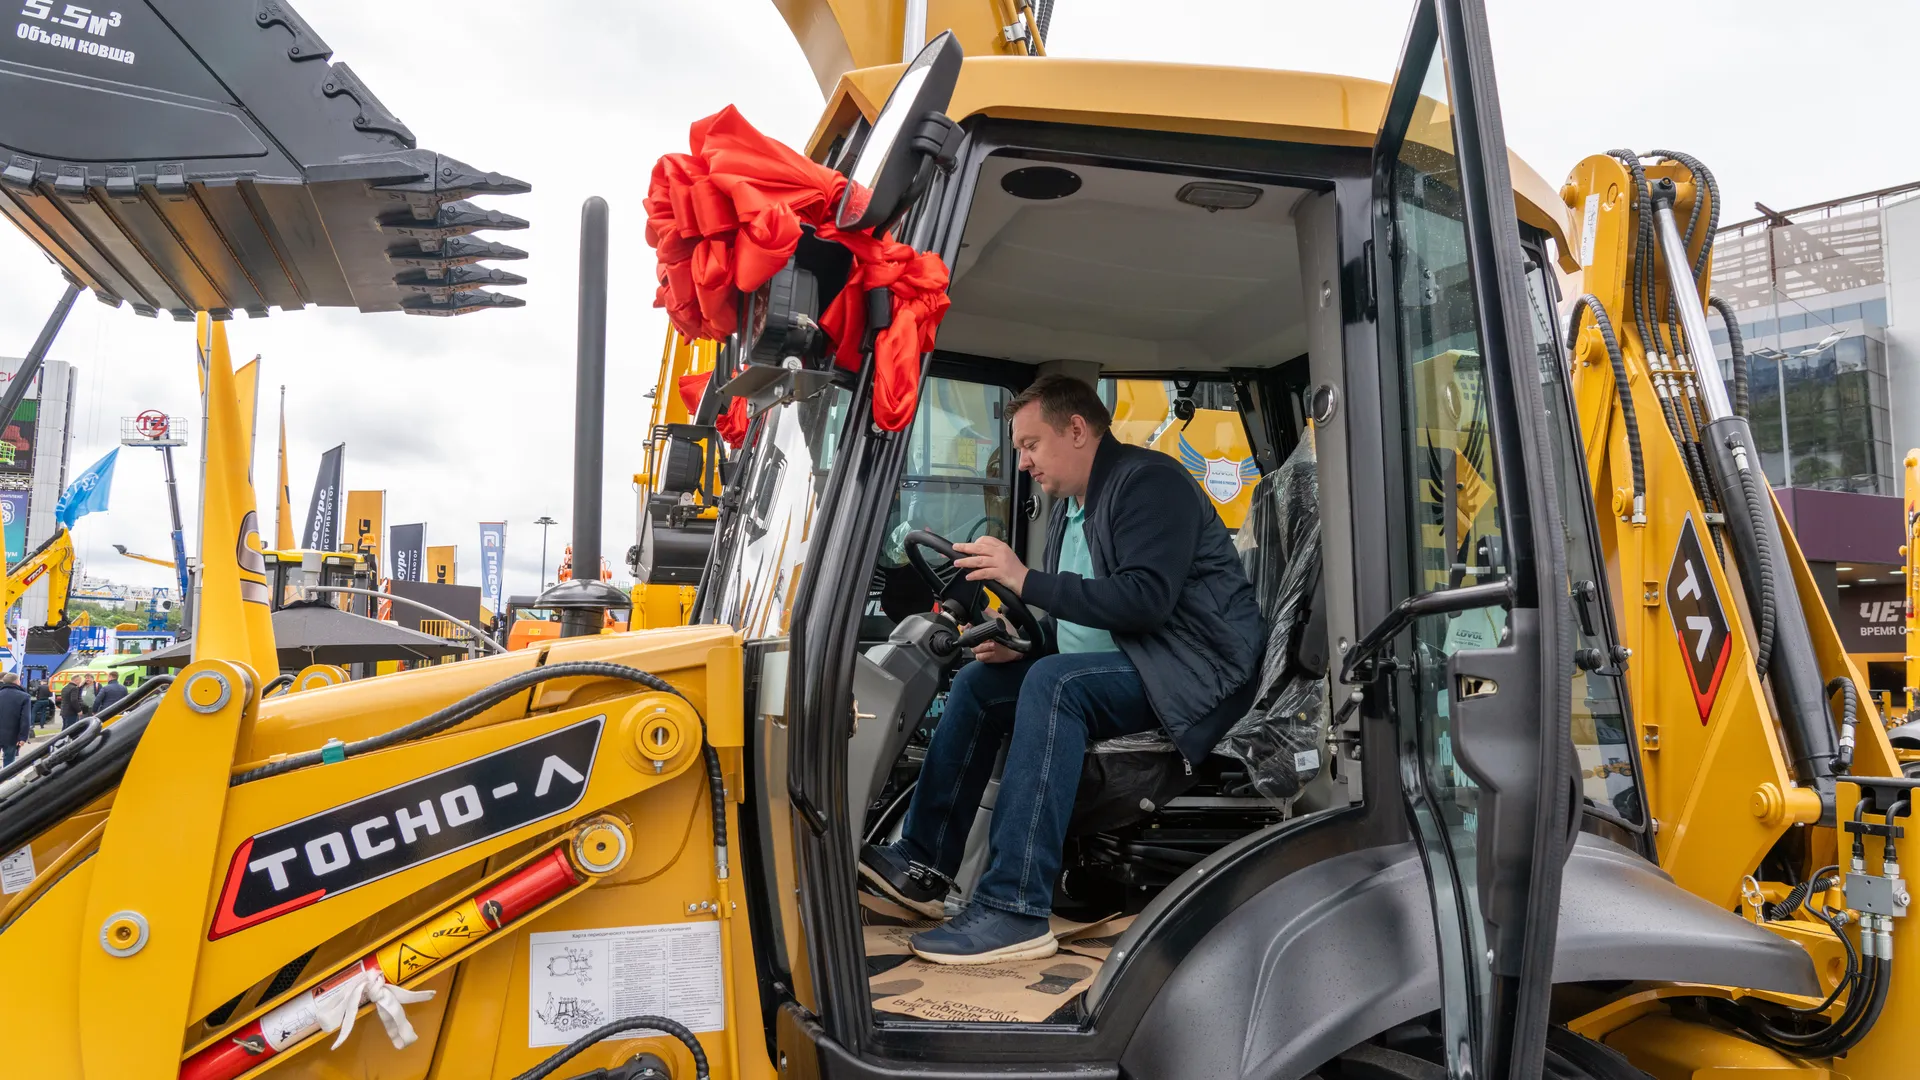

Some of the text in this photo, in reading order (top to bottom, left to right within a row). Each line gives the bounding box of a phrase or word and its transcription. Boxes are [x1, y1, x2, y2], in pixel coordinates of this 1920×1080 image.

[16, 22, 136, 65] Объем ковша
[1860, 626, 1896, 636] ВРЕМЯ
[892, 999, 926, 1008] Ваш
